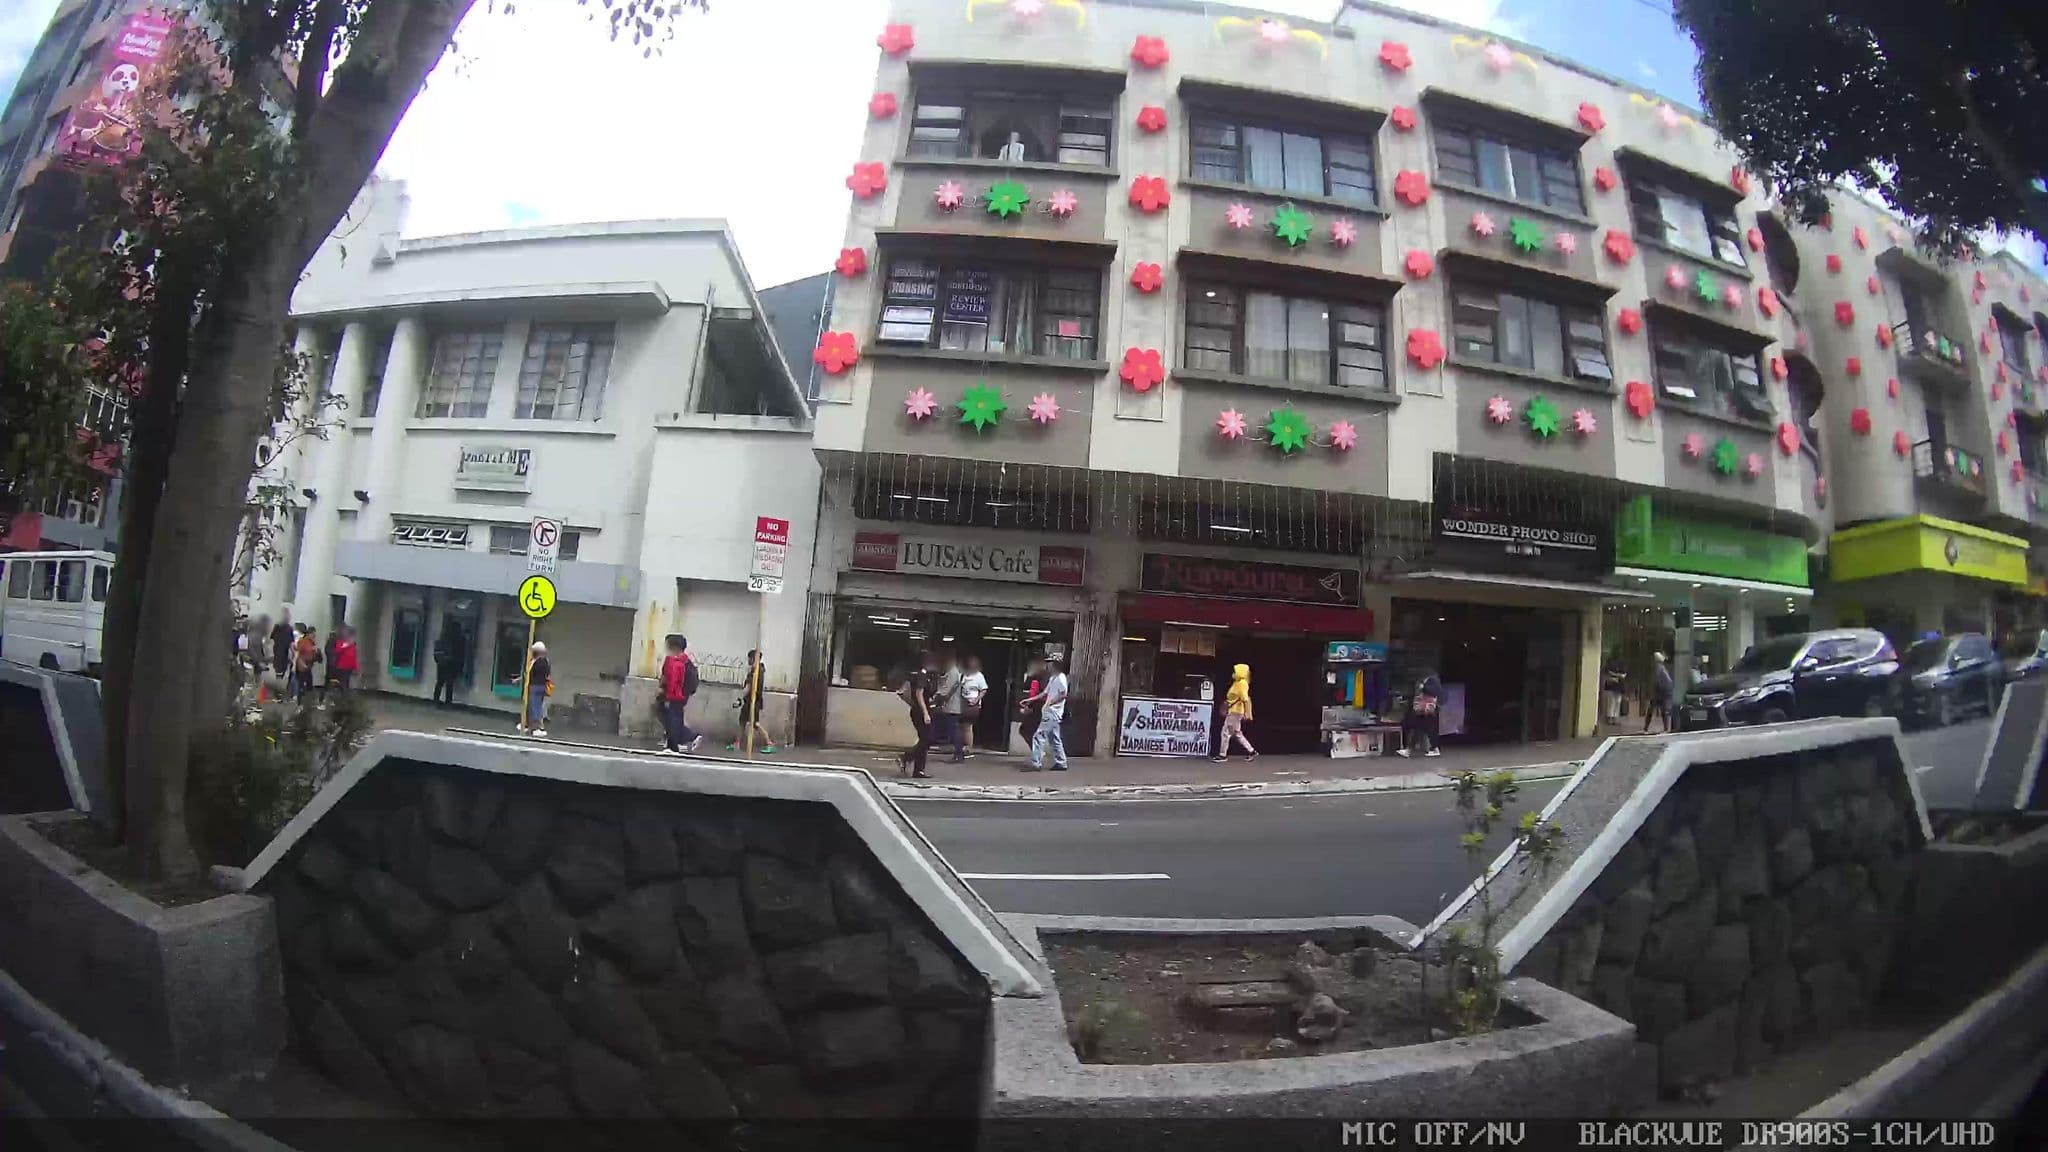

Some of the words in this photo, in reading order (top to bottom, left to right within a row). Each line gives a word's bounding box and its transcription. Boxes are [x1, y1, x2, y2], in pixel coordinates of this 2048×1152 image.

[766, 522, 779, 531] NO
[1441, 518, 1509, 537] WONDER
[1511, 525, 1560, 541] PHOTO
[1563, 531, 1598, 545] SHOP
[756, 531, 786, 543] PARKING
[902, 541, 984, 572] LUISA'S
[988, 547, 1033, 575] Cafe
[530, 562, 556, 573] TURN
[751, 577, 763, 589] 20
[1136, 715, 1206, 733] SHAWARMA
[1121, 735, 1166, 752] JAPANESE
[1166, 738, 1207, 754] TAKOYAKI
